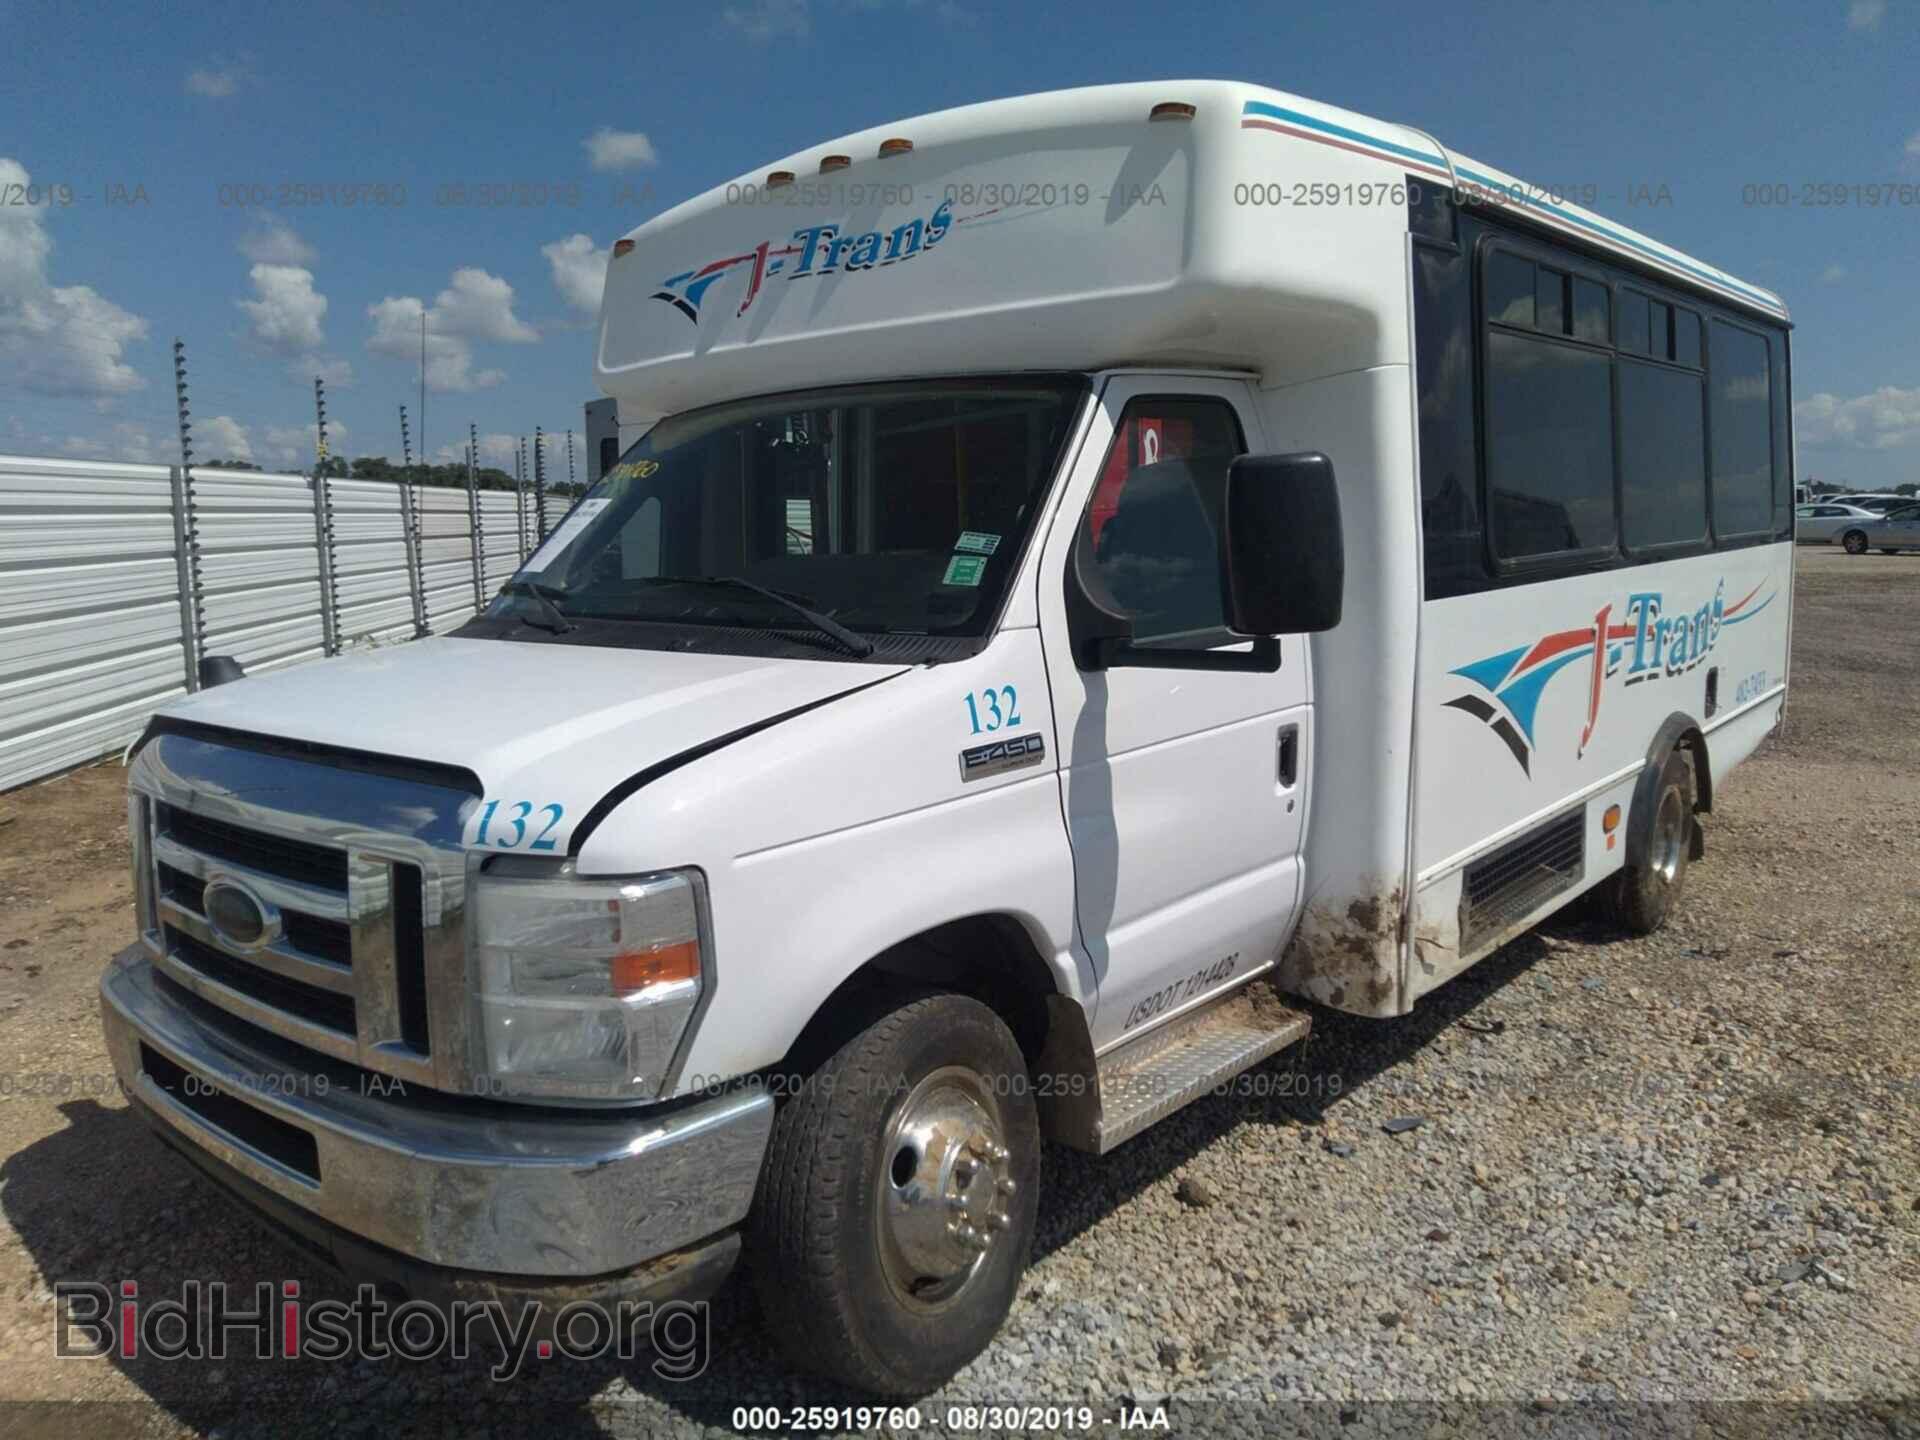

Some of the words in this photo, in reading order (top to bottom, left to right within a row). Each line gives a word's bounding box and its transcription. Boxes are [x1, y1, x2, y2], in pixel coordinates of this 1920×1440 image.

[737, 198, 953, 318] J-Trans
[1577, 576, 1725, 760] J-Trans
[962, 685, 1021, 735] 132
[963, 735, 1045, 768] E-450
[472, 799, 564, 849] 132
[1124, 980, 1184, 1030] USDOT
